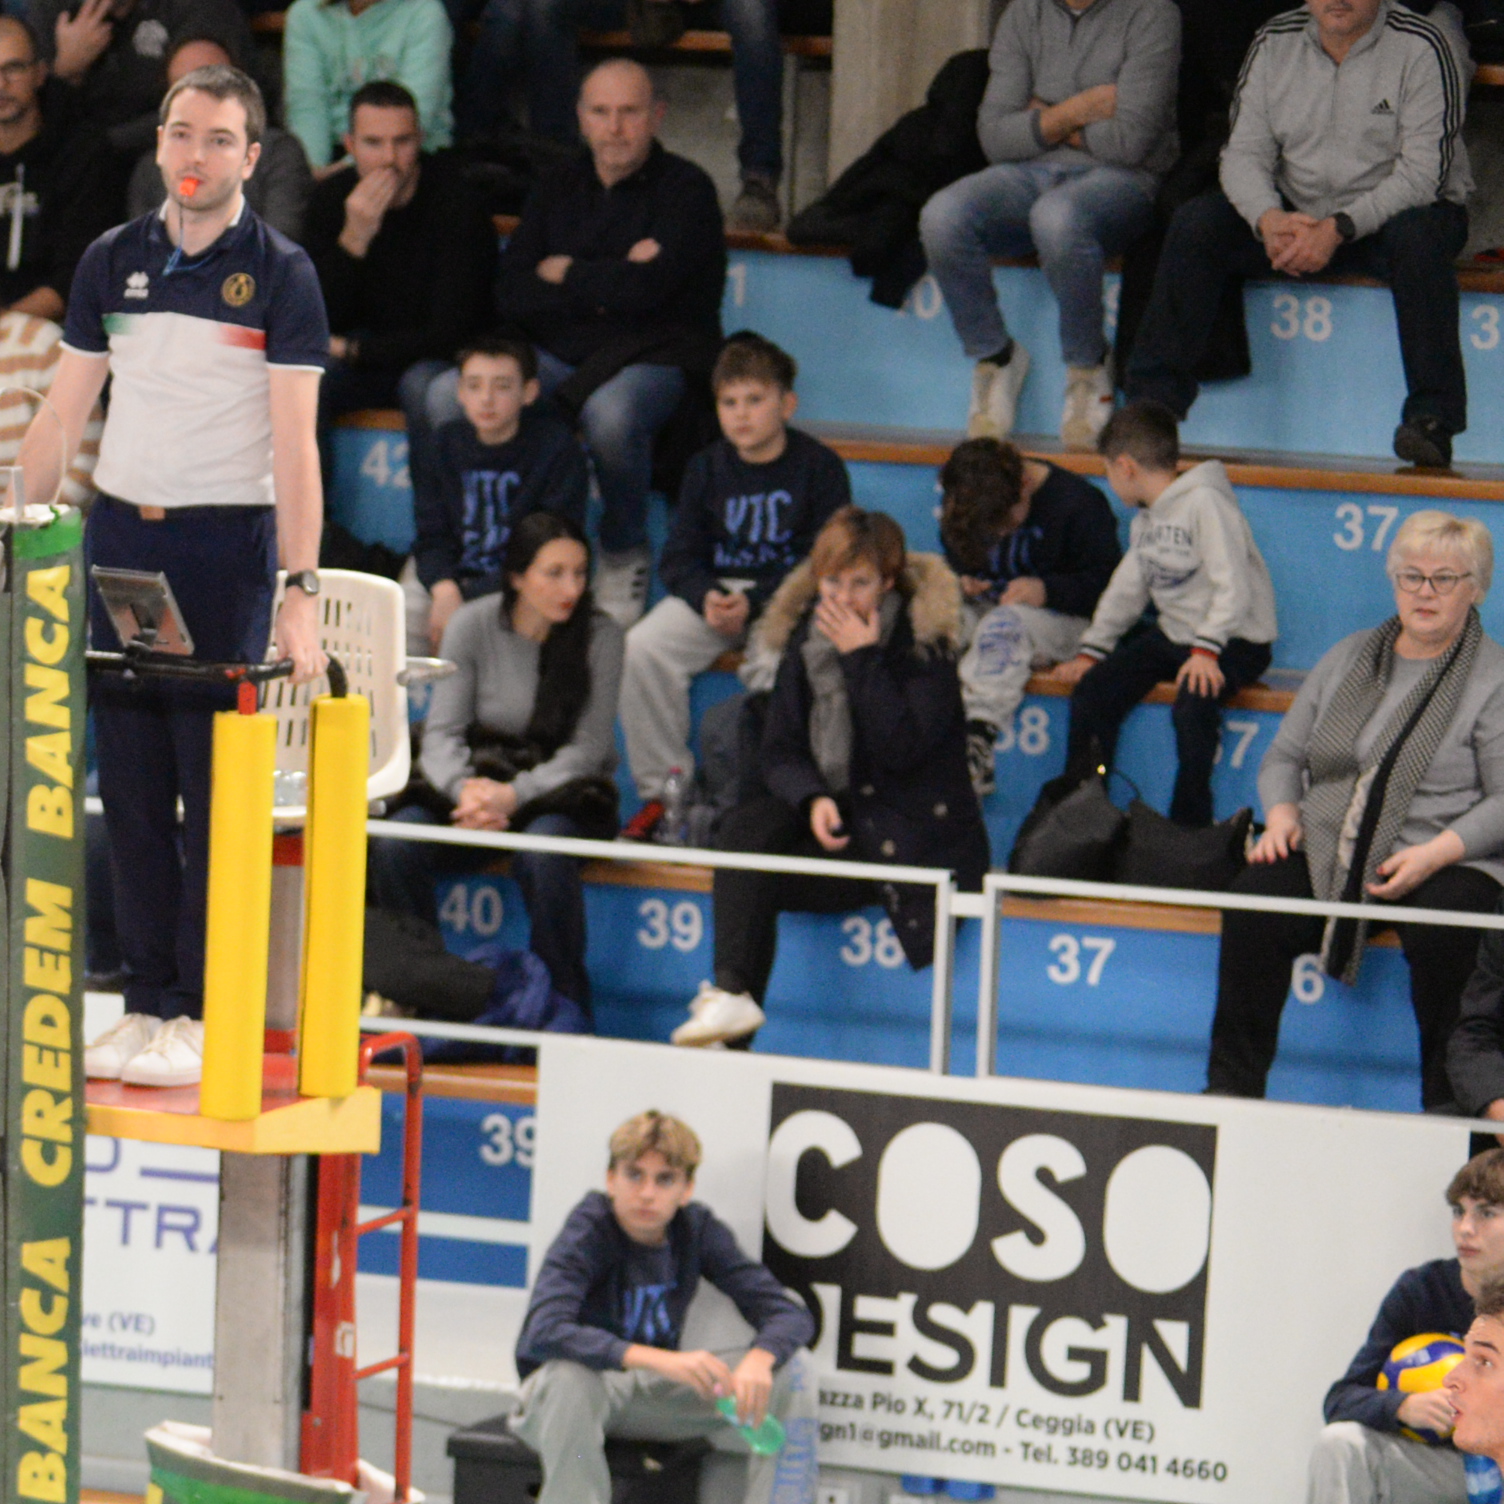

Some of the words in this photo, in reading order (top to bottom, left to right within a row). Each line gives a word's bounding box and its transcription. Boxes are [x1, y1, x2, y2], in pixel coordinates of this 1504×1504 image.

[726, 263, 747, 305] 1
[1271, 295, 1333, 342] 38
[1470, 303, 1503, 351] 3
[1333, 502, 1398, 552] 37
[26, 565, 73, 840] BANCA
[439, 883, 504, 937] 40
[636, 898, 704, 952] 39
[840, 916, 905, 969] 38
[1045, 932, 1117, 988] 37
[1291, 953, 1327, 1005] 6
[20, 877, 73, 1187] CREDEM
[481, 1113, 535, 1166] 39
[765, 1109, 1213, 1295] COSO
[17, 1237, 71, 1504] BANCA
[871, 1391, 906, 1416] Pio
[1015, 1407, 1096, 1438] Ceggia
[1102, 1417, 1157, 1444] (VE)
[818, 1420, 996, 1459] gn1@gmail.com
[1020, 1440, 1060, 1467] Tel.
[1066, 1446, 1109, 1469] 389
[1116, 1451, 1158, 1476] 041
[1165, 1456, 1230, 1483] 4660
